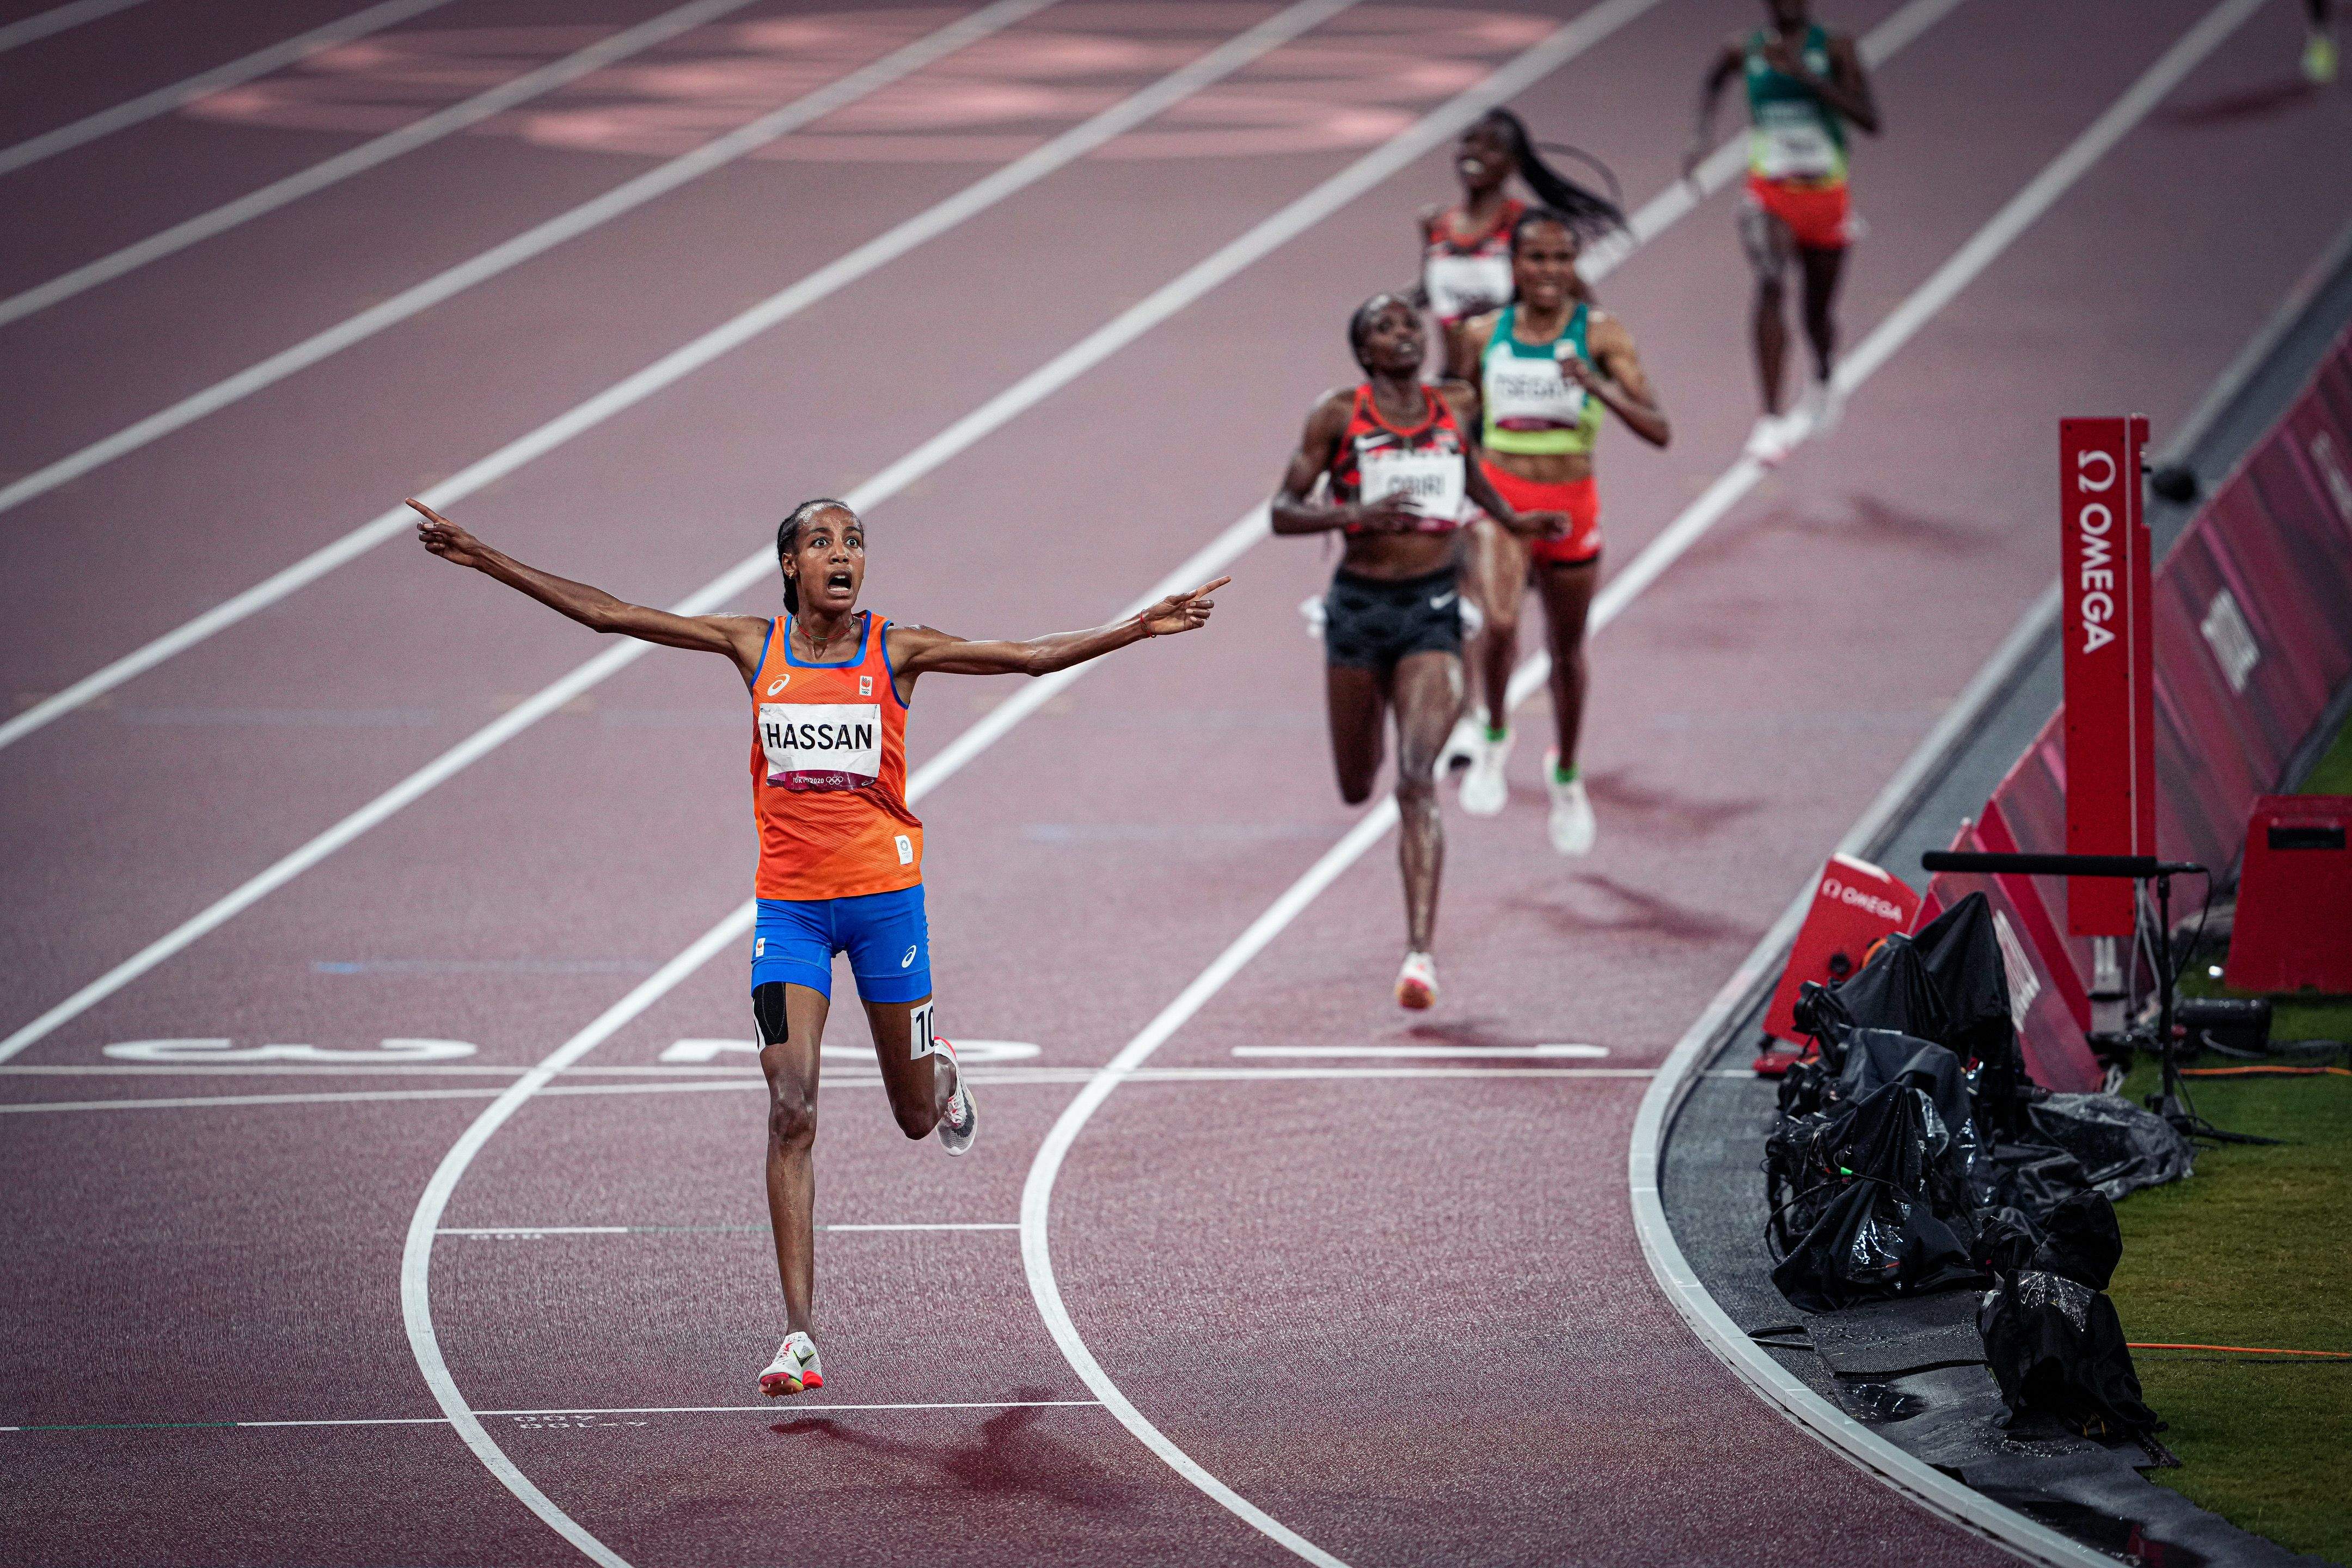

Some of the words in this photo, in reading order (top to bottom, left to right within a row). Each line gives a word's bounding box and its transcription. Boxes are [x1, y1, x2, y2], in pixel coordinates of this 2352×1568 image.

[2079, 503, 2116, 654] OMEGA
[766, 723, 872, 750] HASSAN
[1841, 886, 1903, 924] OMEGA
[916, 1005, 935, 1053] 10
